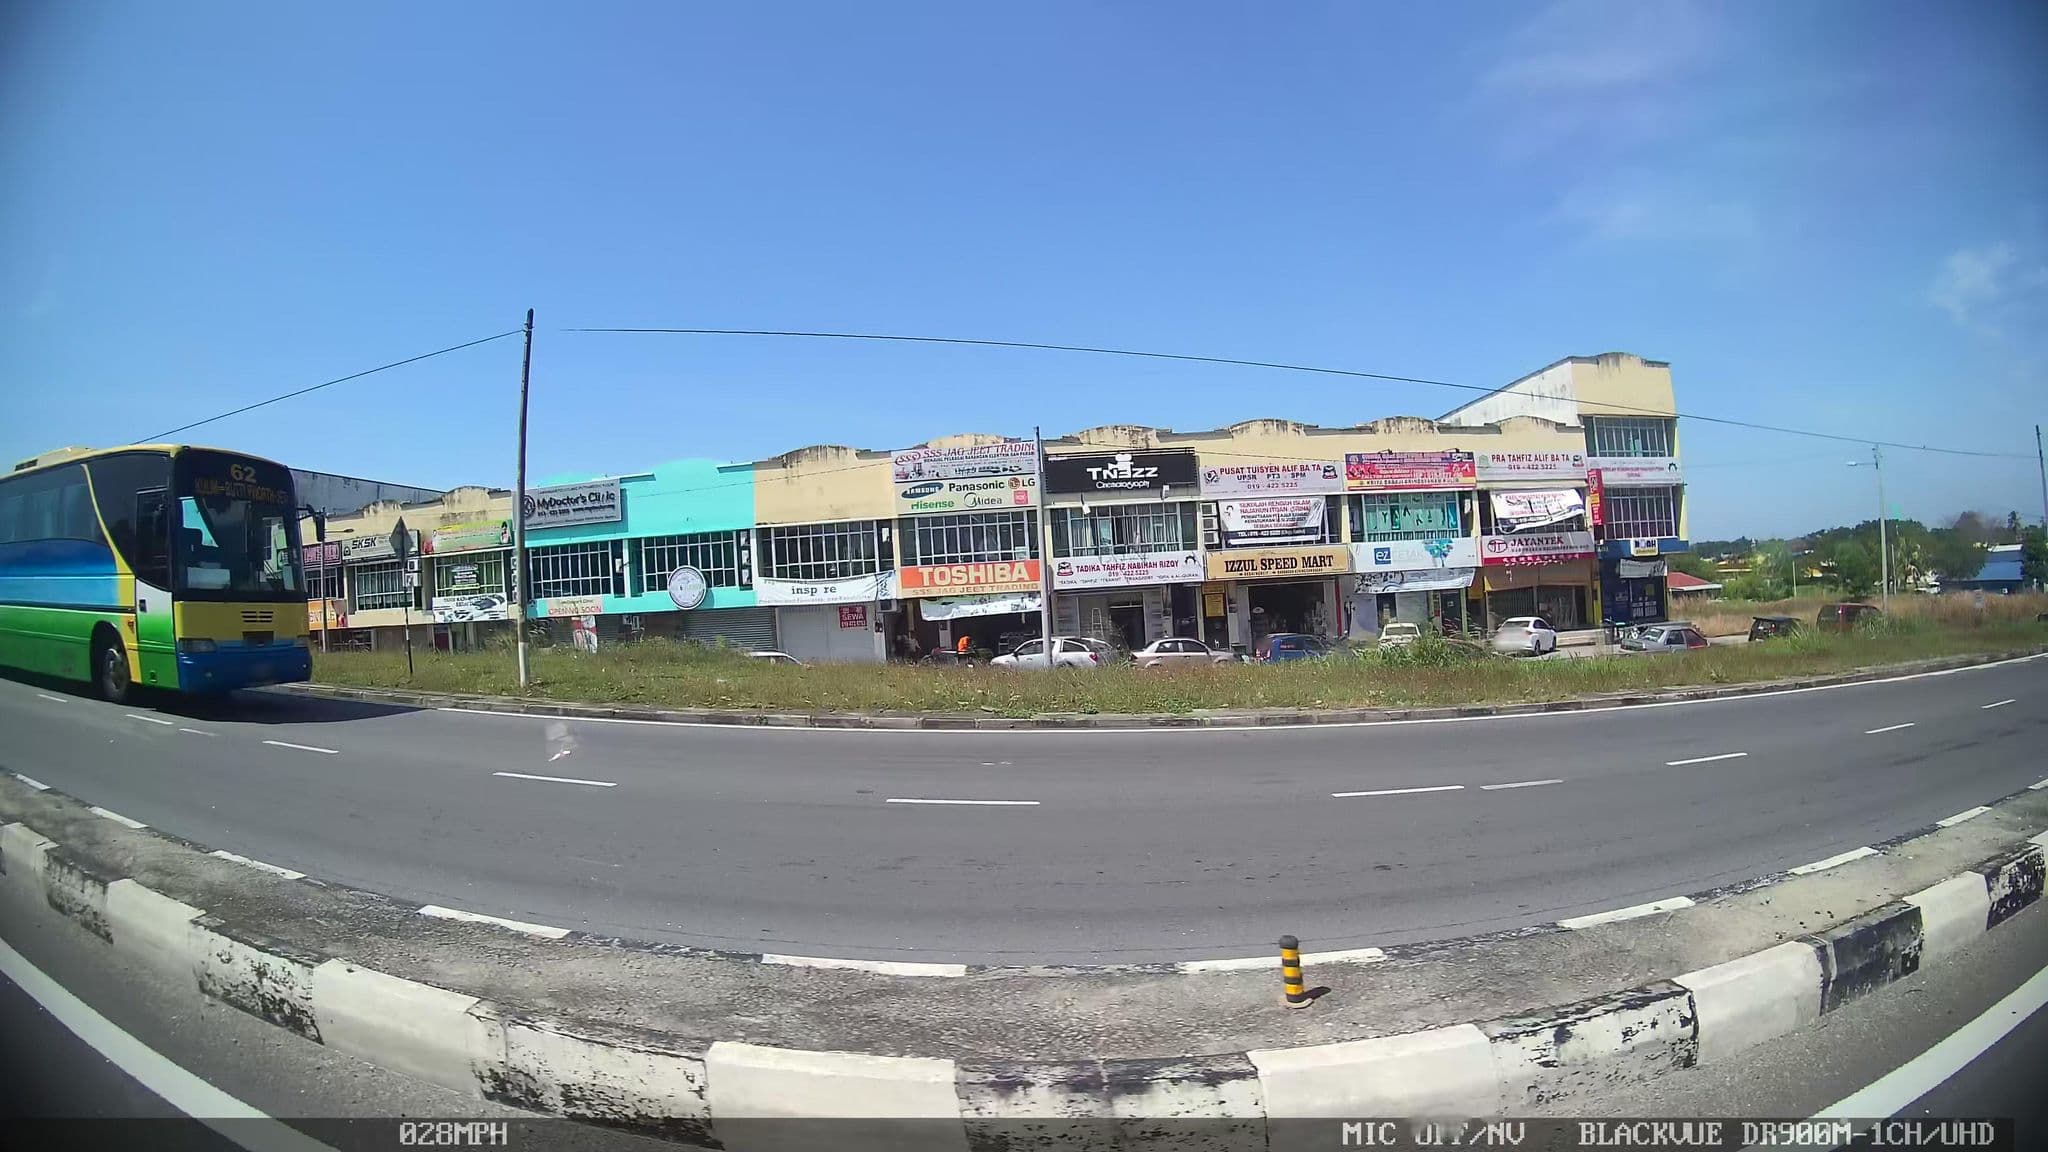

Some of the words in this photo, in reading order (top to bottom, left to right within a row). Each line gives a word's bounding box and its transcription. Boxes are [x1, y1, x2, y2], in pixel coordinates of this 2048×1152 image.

[1491, 454, 1506, 463] PRA
[1508, 454, 1532, 462] TAHFIZ
[1534, 454, 1549, 462] ALIF
[1550, 454, 1560, 462] BA
[1561, 454, 1570, 462] TA
[230, 463, 256, 483] 62
[1219, 467, 1244, 476] PUSAT
[1246, 465, 1280, 474] TUISYEN
[1281, 464, 1298, 473] ALIF
[1299, 464, 1310, 472] BA
[1311, 463, 1321, 472] TA
[948, 480, 1005, 492] Panasonic
[1022, 478, 1036, 487] LG
[906, 486, 940, 495] SAMSUNG
[536, 494, 588, 510] MyDoctor's
[911, 499, 955, 510] Hisense
[352, 537, 377, 550] SKSK
[1511, 536, 1564, 547] JAYANTEK
[1076, 564, 1100, 573] TADIKA
[1102, 562, 1126, 571] TAHFIZ
[1224, 559, 1258, 573] IZZUL
[1260, 557, 1297, 571] SPEED
[1301, 555, 1334, 569] MART
[918, 562, 1031, 587] TOSHIBA
[959, 585, 985, 593] JEET
[990, 582, 1038, 592] TRADING
[841, 613, 865, 621] SEWA
